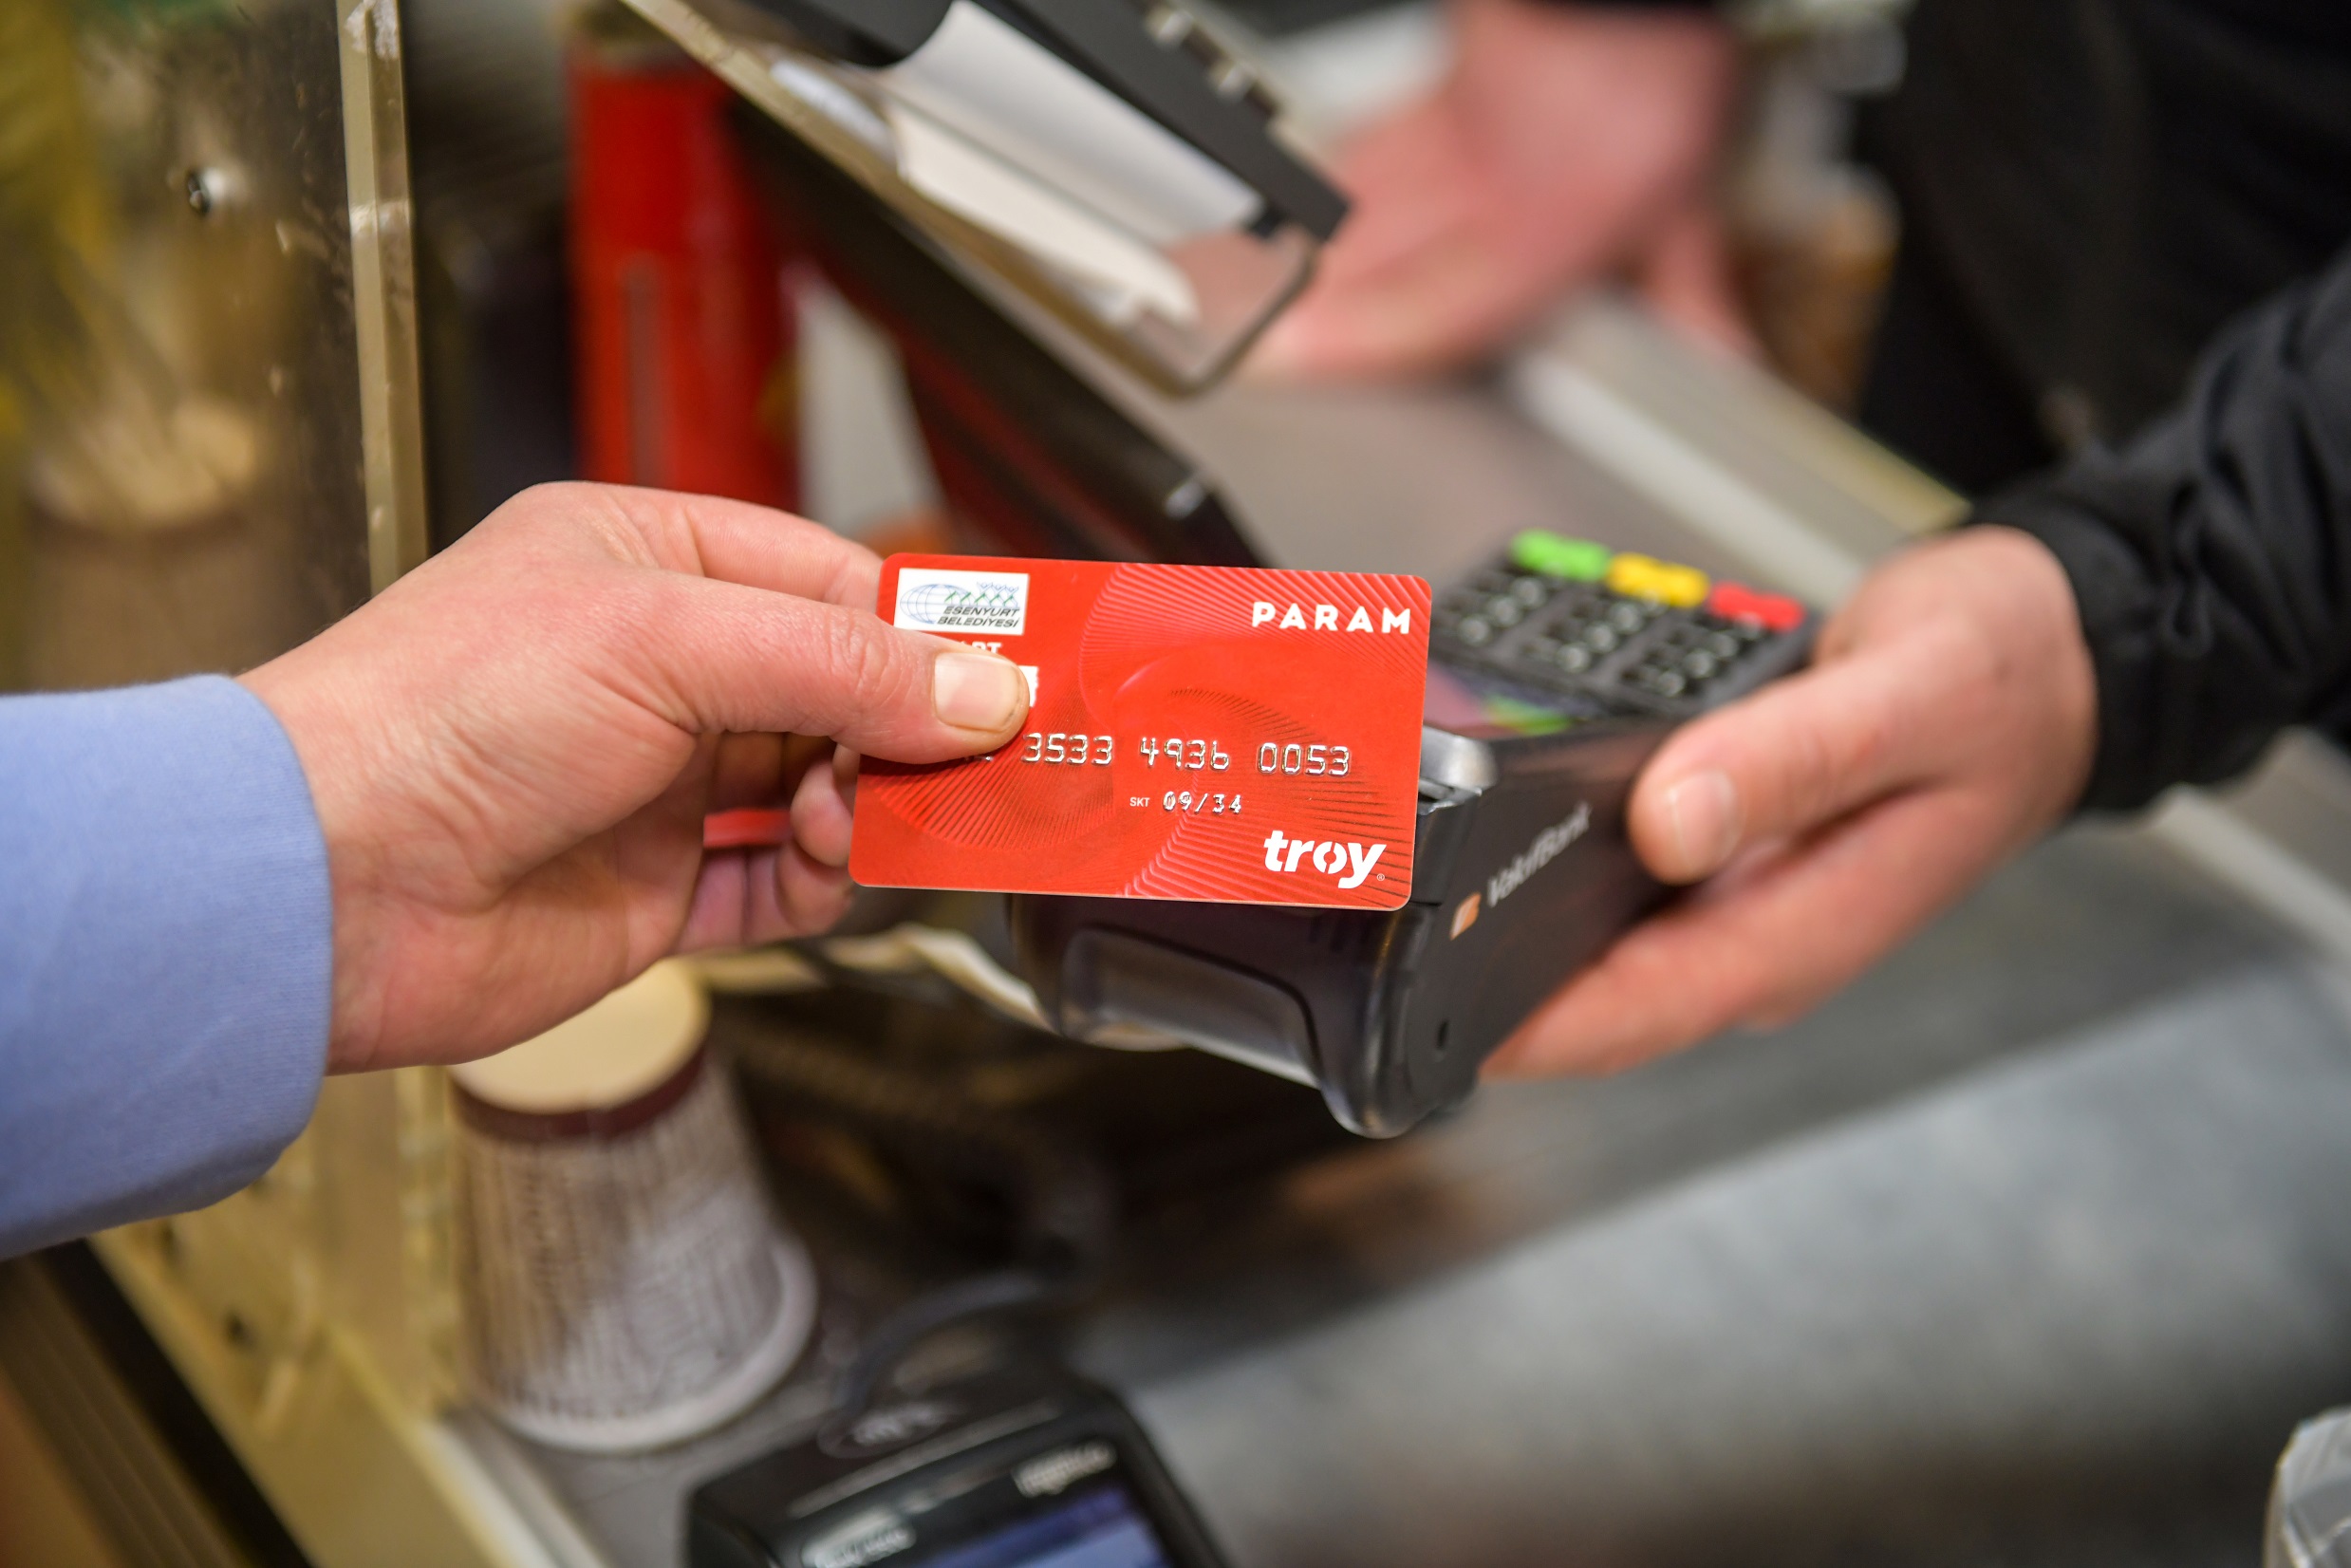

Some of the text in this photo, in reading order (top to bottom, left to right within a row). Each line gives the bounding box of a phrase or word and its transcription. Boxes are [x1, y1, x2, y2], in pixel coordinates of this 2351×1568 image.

[937, 615, 1020, 628] BELEDİYESİ
[942, 606, 1020, 618] ESENYURT
[1252, 601, 1411, 635] PARAM
[1020, 732, 1352, 777] 3533 4936 0053
[1129, 790, 1242, 815] SKT 09/34
[1263, 830, 1388, 889] troy
